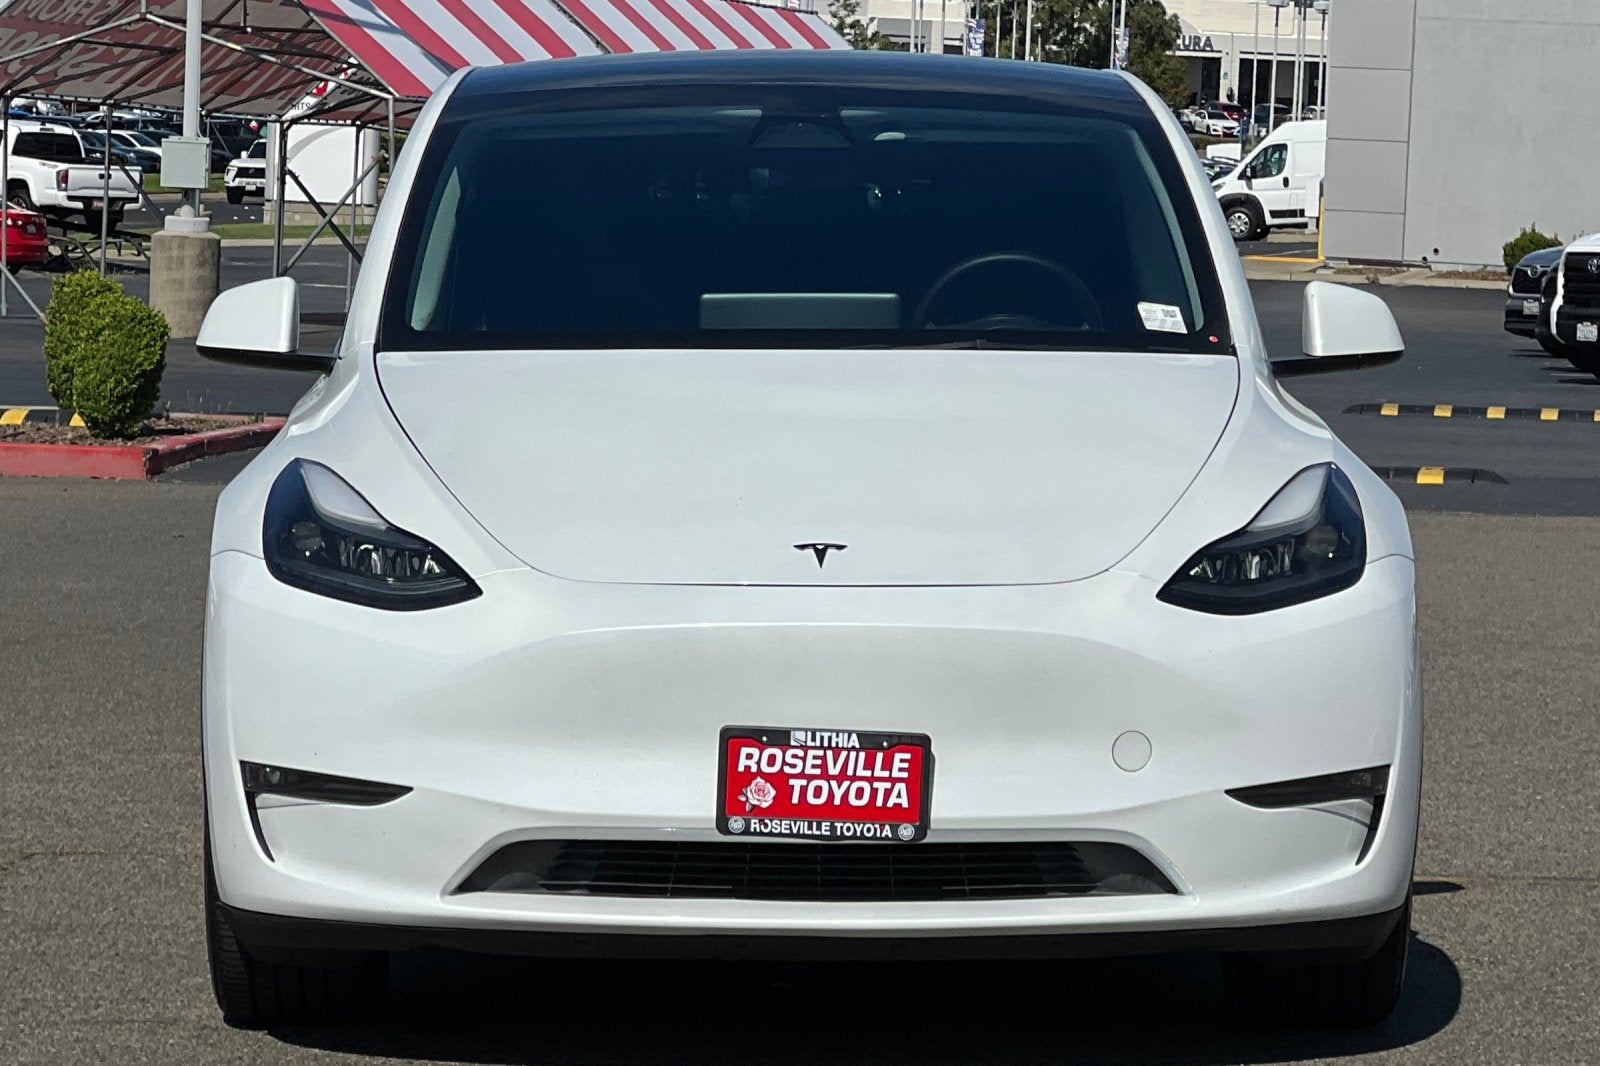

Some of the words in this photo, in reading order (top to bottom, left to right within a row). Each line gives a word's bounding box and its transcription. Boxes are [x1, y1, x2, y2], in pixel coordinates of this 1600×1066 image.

[1176, 35, 1214, 50] URA
[807, 731, 860, 748] LITHIA
[737, 747, 912, 778] ROSEVILLE
[788, 778, 909, 808] TOYOTA
[750, 819, 831, 836] ROSEVILLE
[834, 822, 892, 838] TOYOTA
